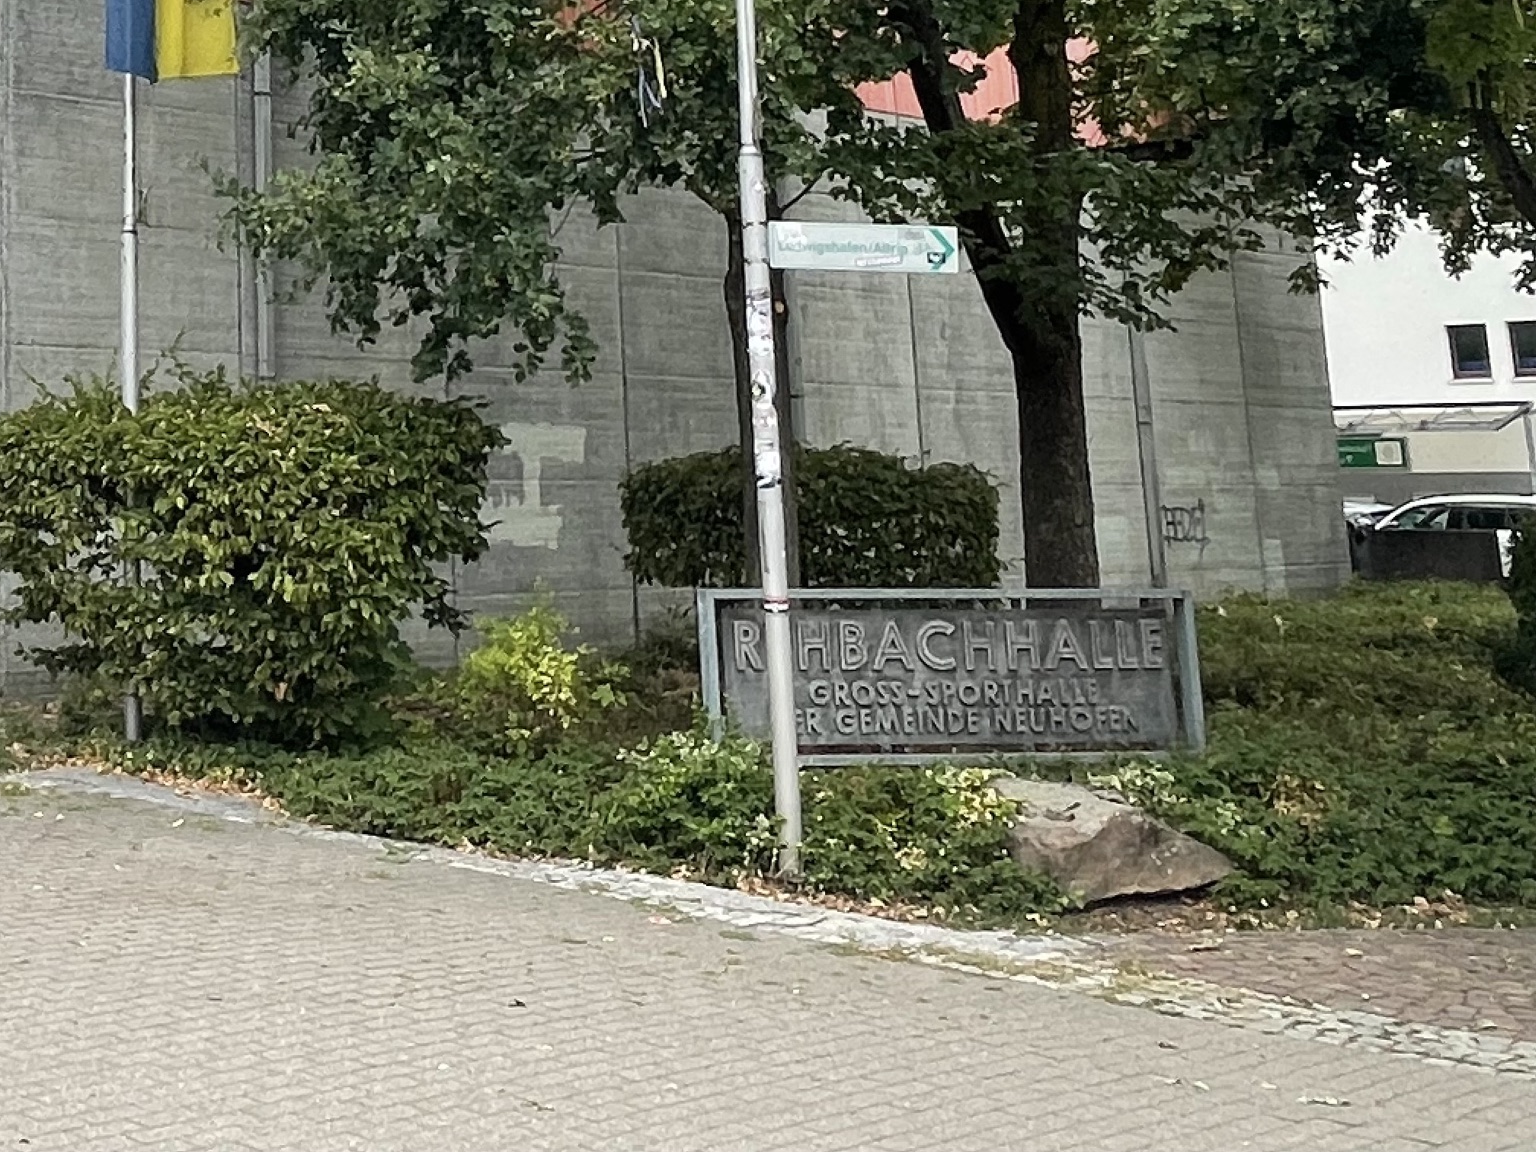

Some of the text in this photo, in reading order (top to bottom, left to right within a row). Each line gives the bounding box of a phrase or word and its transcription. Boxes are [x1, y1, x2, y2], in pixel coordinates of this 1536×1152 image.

[732, 618, 1164, 672] RHBACHHALLE
[808, 678, 1099, 707] GROSS-SPORTHALLE
[796, 705, 1141, 735] ER GEMEINDE NEUHOFEN
